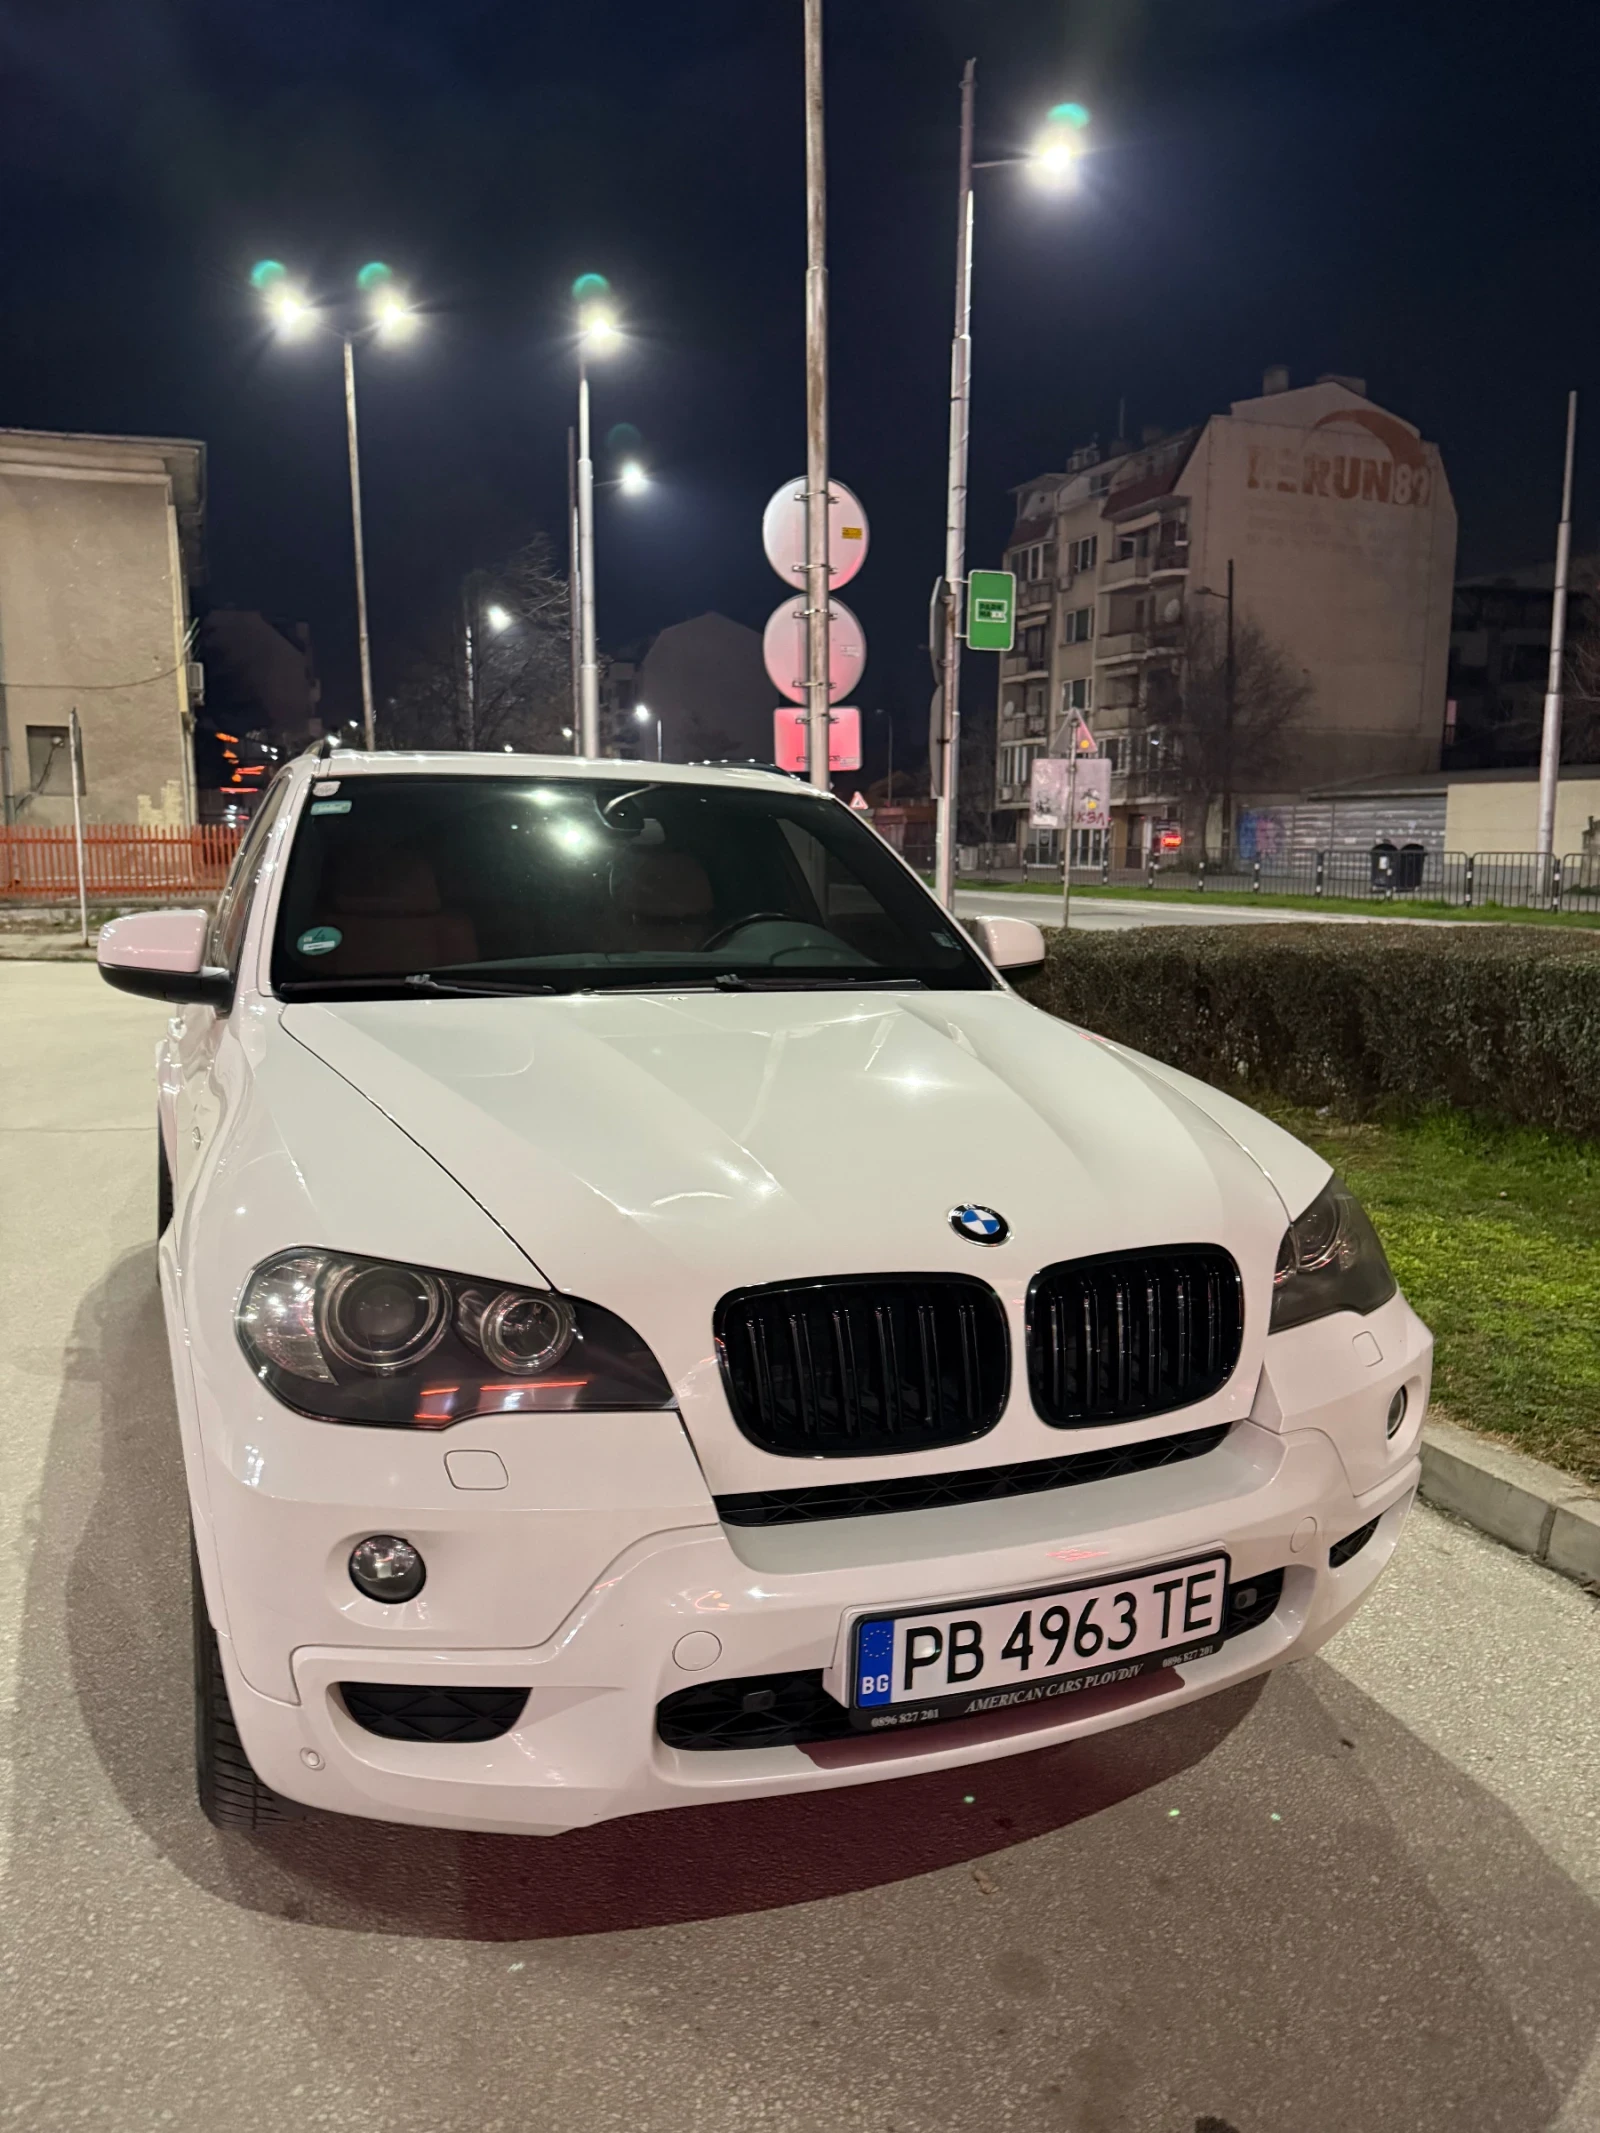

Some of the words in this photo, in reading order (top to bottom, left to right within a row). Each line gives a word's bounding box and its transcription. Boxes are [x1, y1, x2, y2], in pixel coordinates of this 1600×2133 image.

[904, 1620, 984, 1690] PB
[1001, 1592, 1137, 1671] 4963
[1153, 1569, 1216, 1639] TE
[1183, 1649, 1199, 1662] 827
[861, 1674, 889, 1695] BG
[964, 1686, 1045, 1714] AMERICAN
[1046, 1678, 1083, 1697] CARS
[1084, 1663, 1144, 1689] PLOVDIV
[871, 1715, 898, 1728] 0896
[898, 1711, 919, 1724] 827
